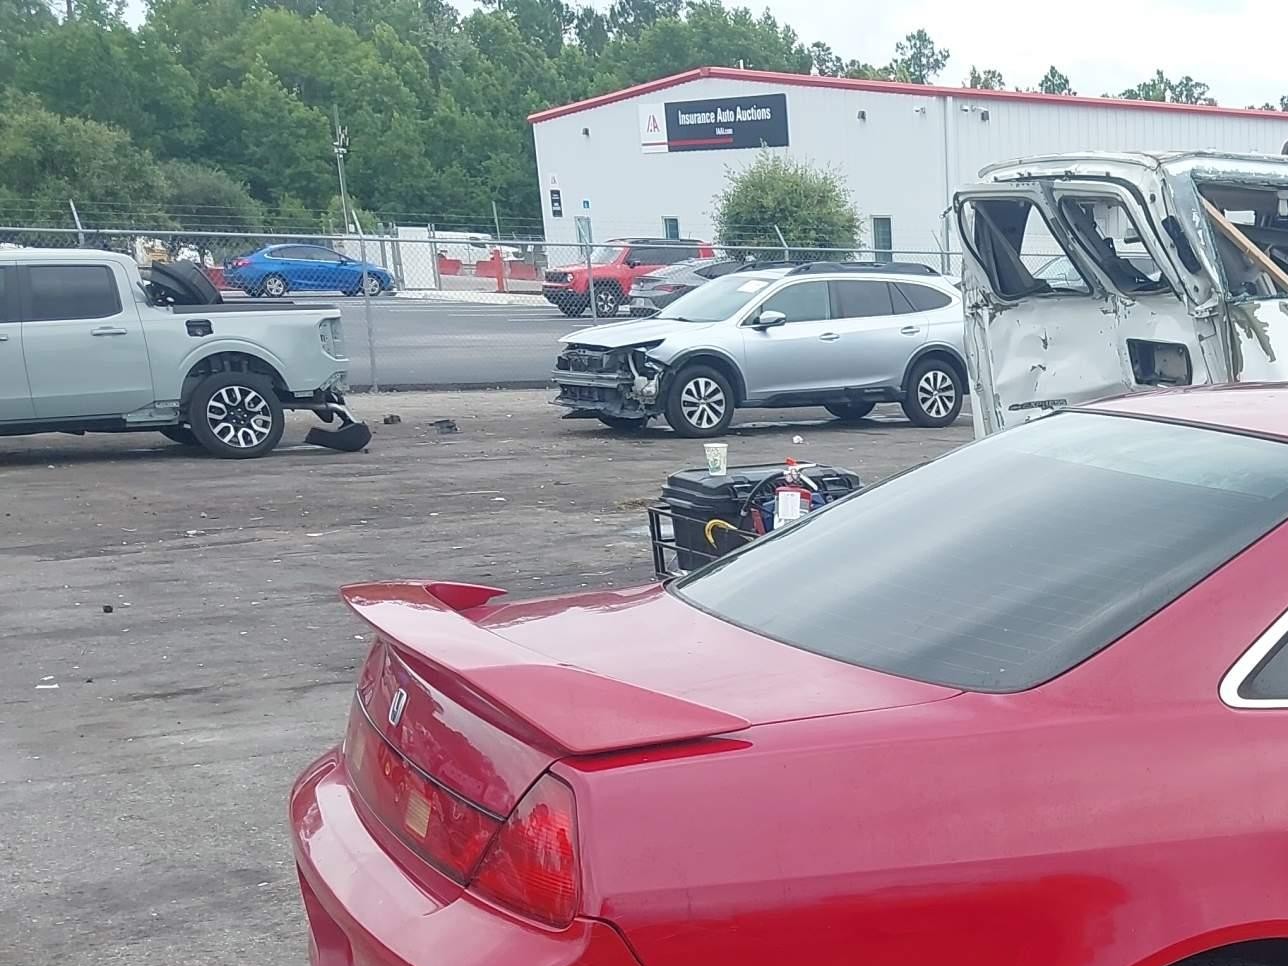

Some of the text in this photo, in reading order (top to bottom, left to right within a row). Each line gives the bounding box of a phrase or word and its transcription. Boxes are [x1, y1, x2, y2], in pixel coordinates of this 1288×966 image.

[678, 104, 771, 126] Insurance Auto Auctions
